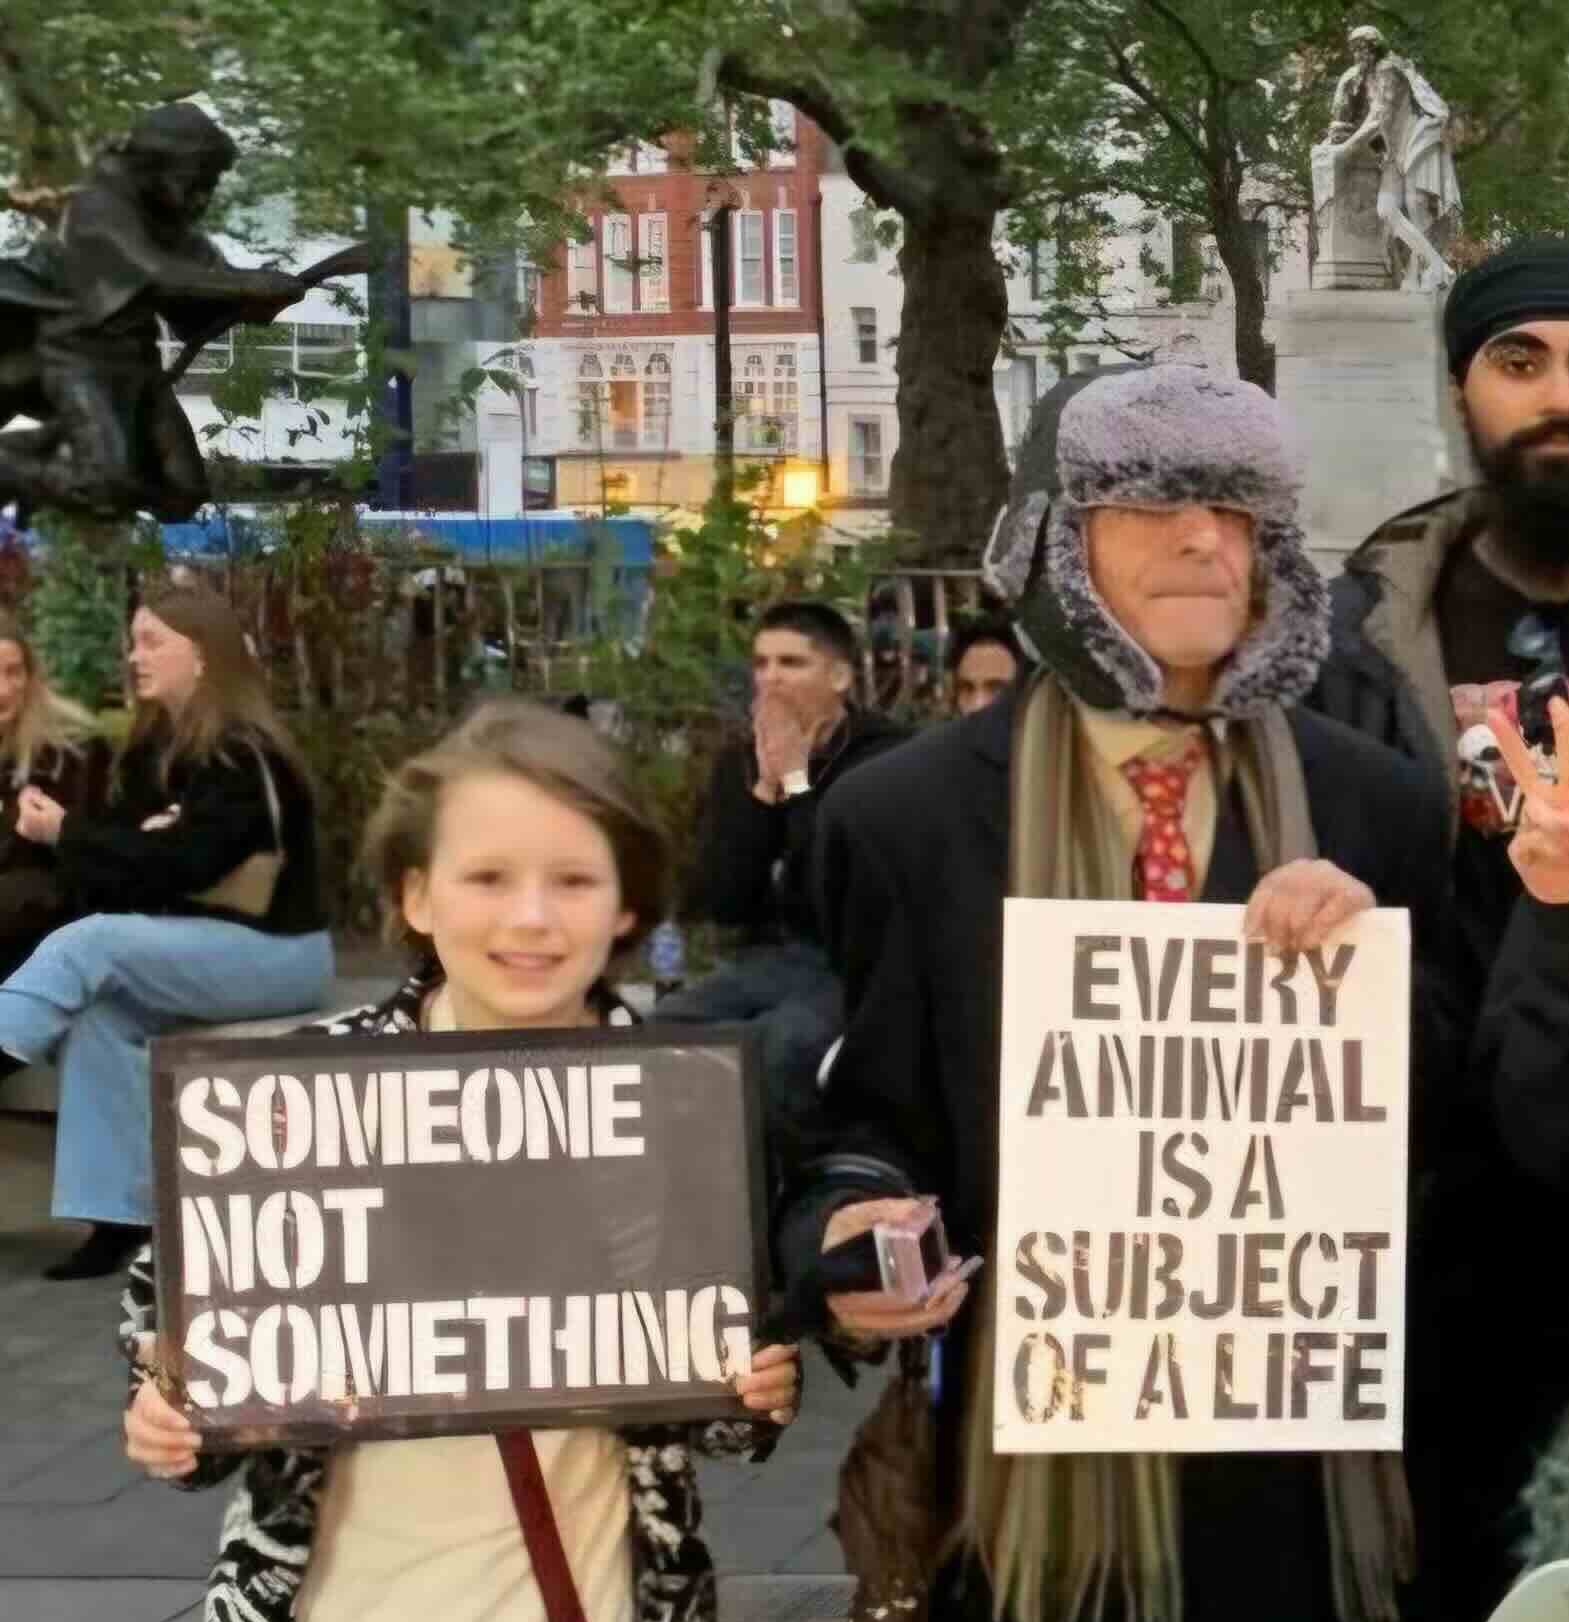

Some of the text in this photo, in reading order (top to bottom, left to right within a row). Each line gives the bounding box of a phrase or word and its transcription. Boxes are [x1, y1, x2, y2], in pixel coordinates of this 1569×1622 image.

[1071, 934, 1356, 1026] EVERY
[179, 1064, 645, 1176] SOMEONE
[1026, 1031, 1388, 1123] ANIMAL
[1136, 1131, 1285, 1219] IS A
[181, 1188, 384, 1297] NOT
[1015, 1231, 1391, 1321] SUBJECT
[183, 1285, 752, 1408] SOMETHING
[1014, 1331, 1388, 1423] OF A LIFE
